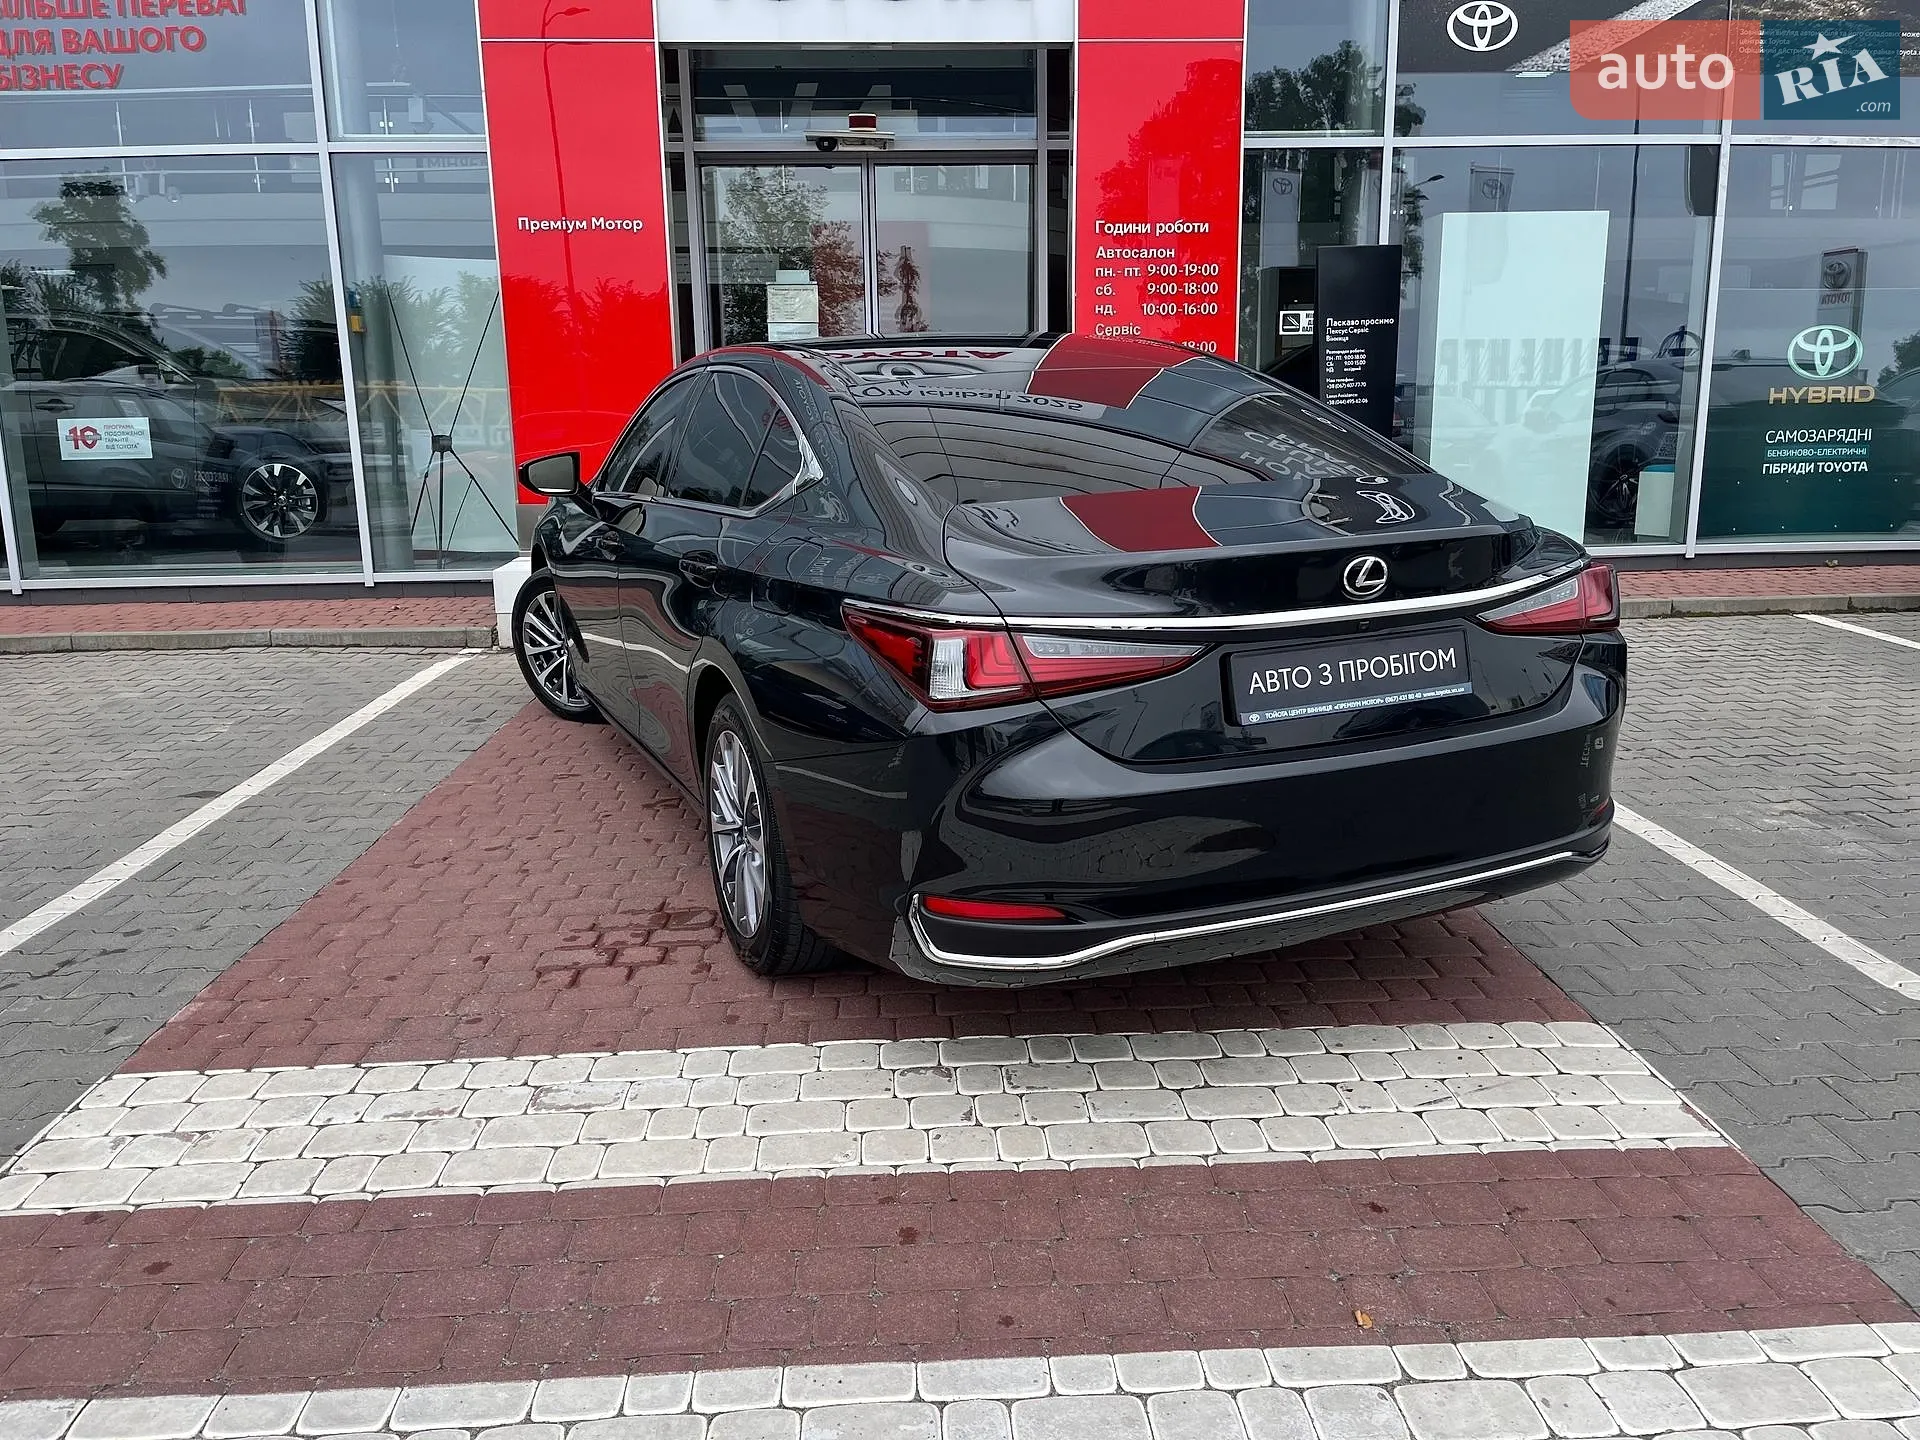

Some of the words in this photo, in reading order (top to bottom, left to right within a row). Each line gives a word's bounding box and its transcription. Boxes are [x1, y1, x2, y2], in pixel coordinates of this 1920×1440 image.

[62, 25, 205, 54] ВАШОГО
[518, 217, 587, 233] Преміум
[591, 217, 643, 232] Мотор
[1095, 220, 1151, 236] Години
[1156, 219, 1209, 236] роботи
[1096, 246, 1175, 258] Автосалон
[1147, 264, 1219, 276] 9:00-19:00
[1095, 283, 1116, 295] сб.
[1147, 282, 1219, 295] 9:00-18:00
[1095, 305, 1117, 316] нд.
[1141, 303, 1218, 315] 10:00-16:00
[1095, 322, 1141, 336] Сервіс
[1768, 385, 1876, 404] HYBRID
[1765, 428, 1872, 443] САМОЗАРЯДНІ
[1767, 447, 1867, 457] БЕНЗИНОВО-ЕЛЕКТРИЧНІ
[1762, 462, 1816, 475] ГІБРИДИ
[1816, 461, 1868, 473] TOYOTA
[1249, 666, 1312, 695] АВТО
[1318, 663, 1333, 686] З
[1339, 647, 1457, 683] ПРОБІГОМ
